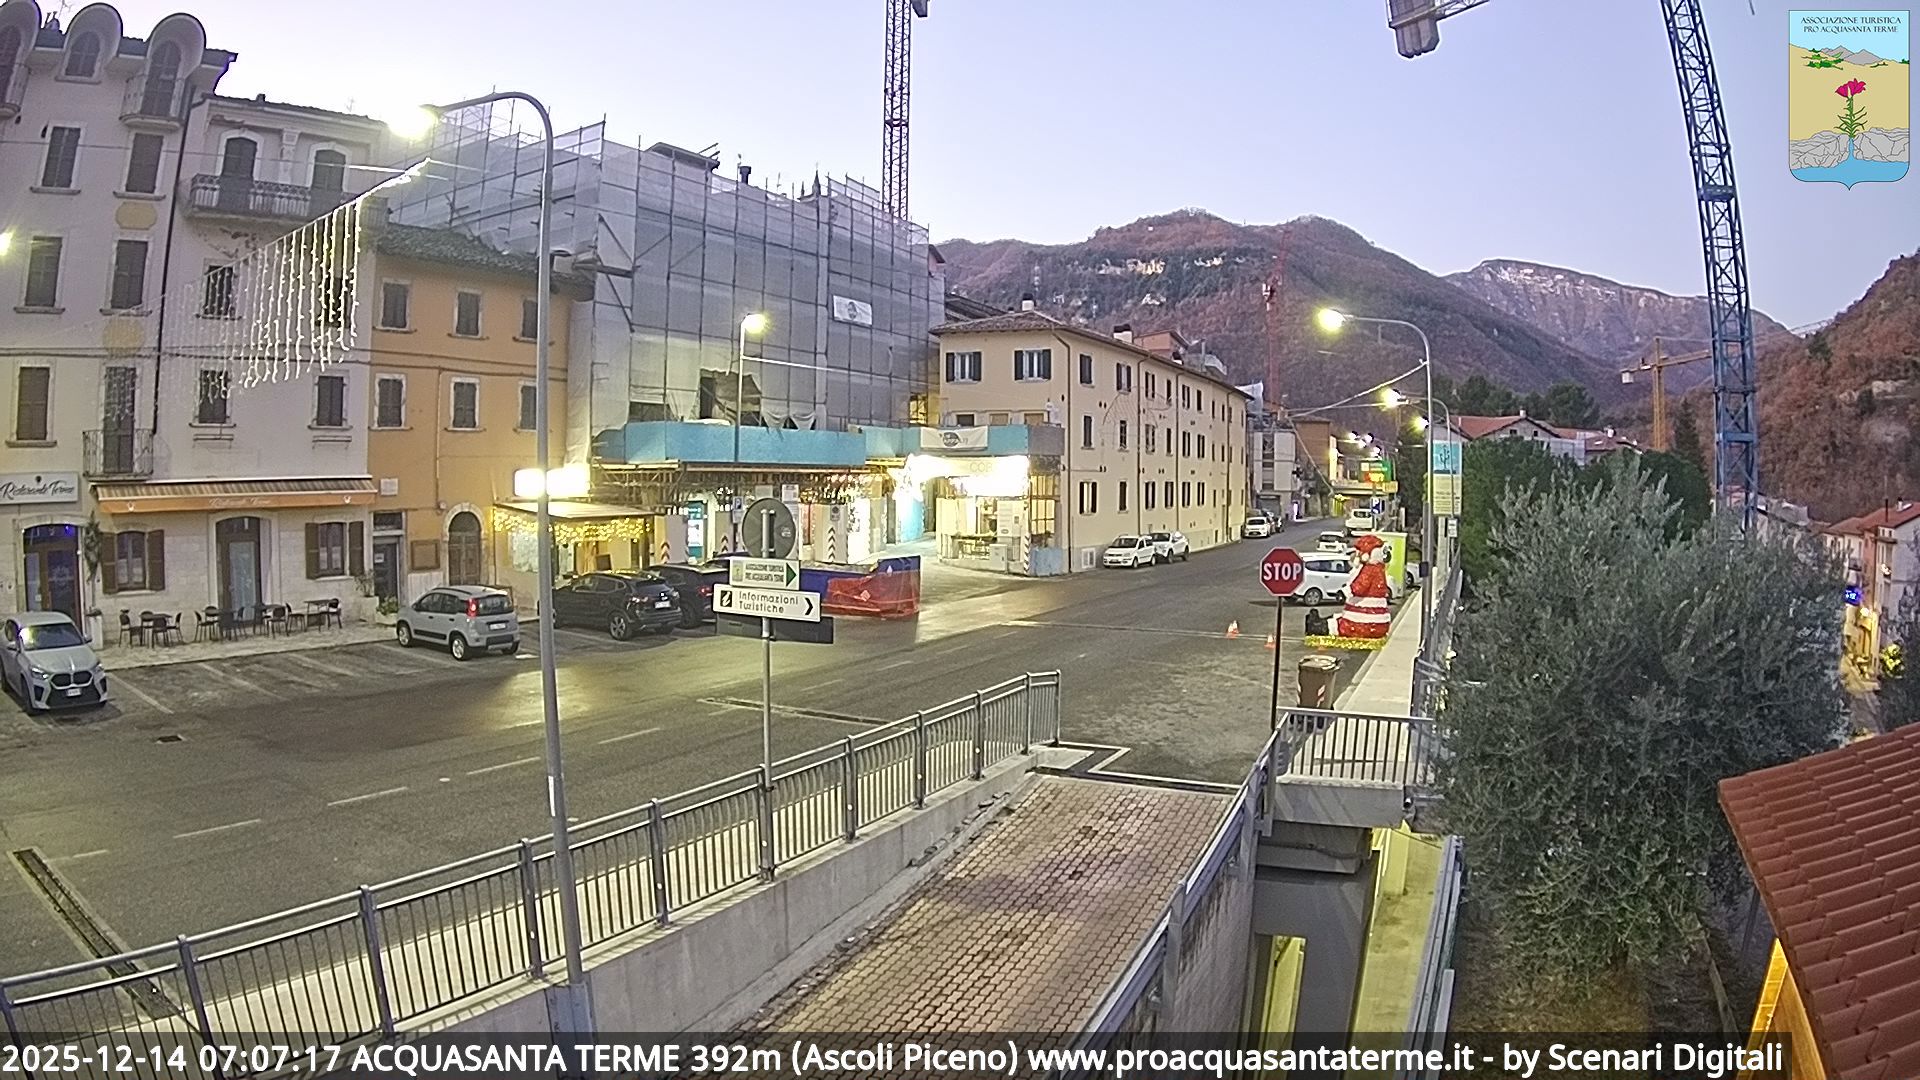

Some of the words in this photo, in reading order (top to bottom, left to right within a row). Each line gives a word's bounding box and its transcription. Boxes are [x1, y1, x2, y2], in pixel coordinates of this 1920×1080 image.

[1263, 562, 1302, 580] STOP
[739, 591, 799, 605] Informazioni
[739, 601, 784, 613] Turistiche
